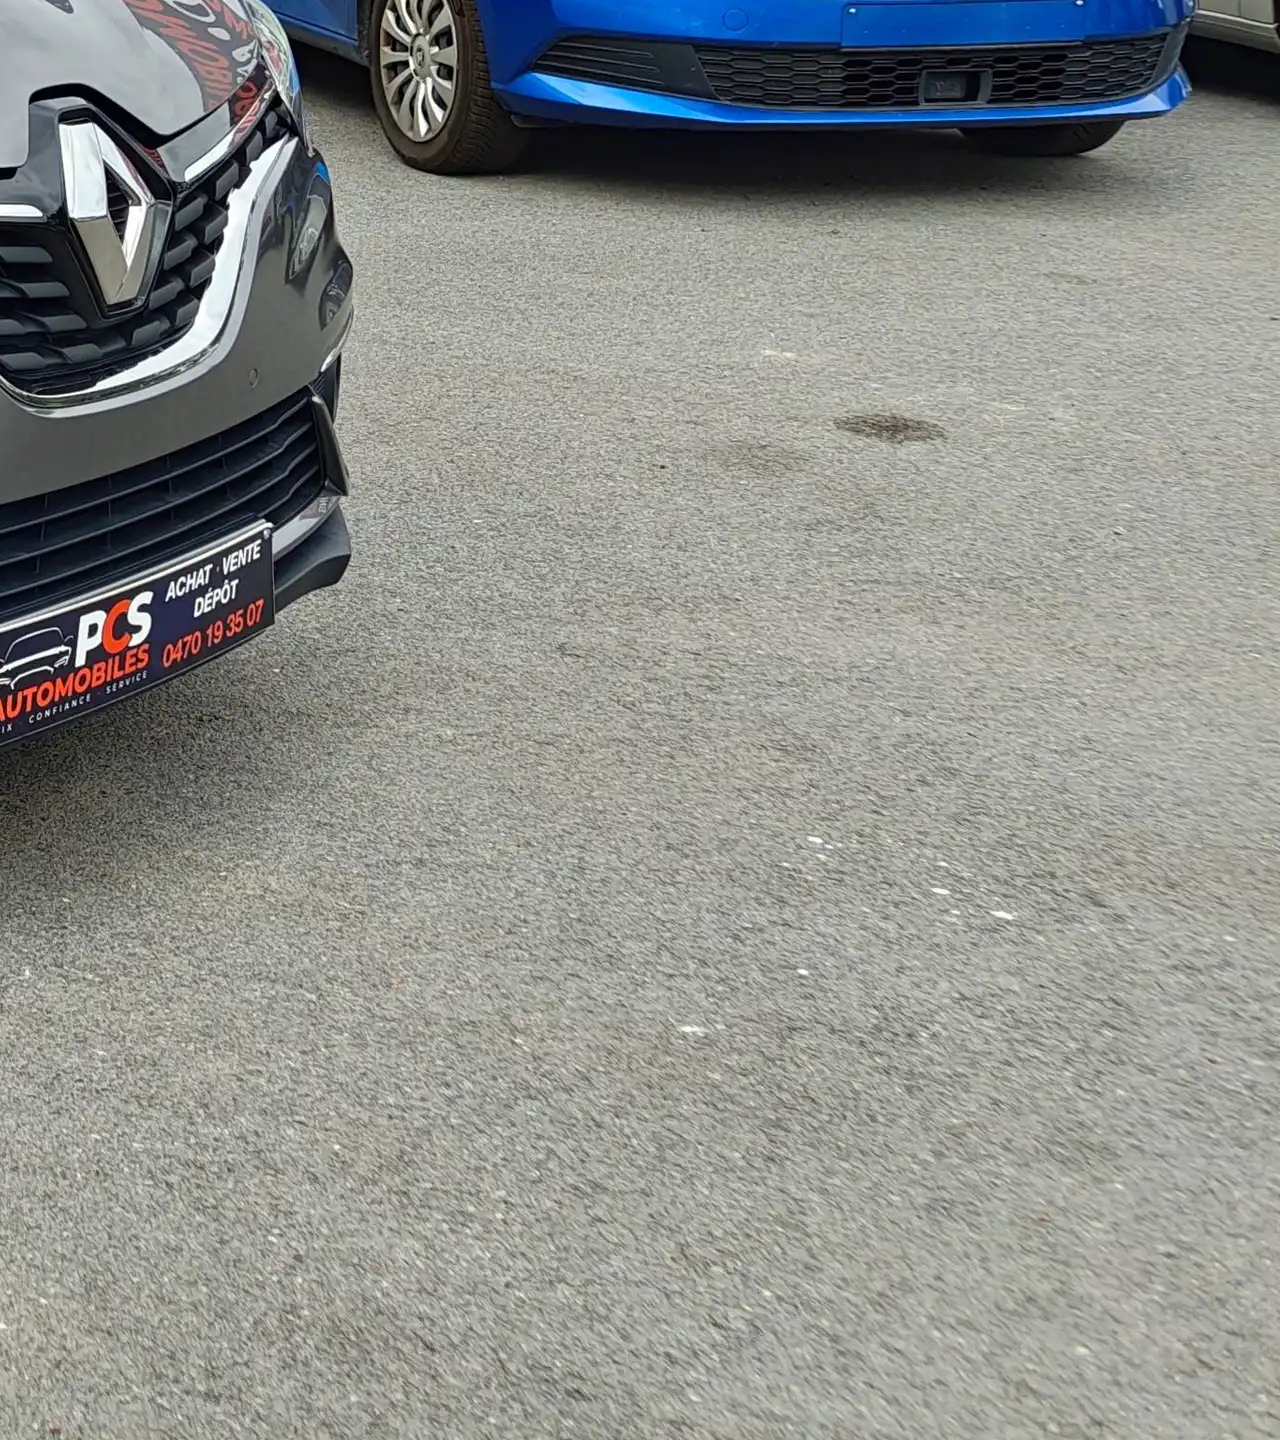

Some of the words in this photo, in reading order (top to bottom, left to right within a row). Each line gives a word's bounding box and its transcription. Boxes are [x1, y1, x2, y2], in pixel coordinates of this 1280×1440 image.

[164, 563, 213, 602] ACHAT
[222, 539, 262, 576] VENTE
[193, 579, 239, 618] DÉPÔT
[74, 590, 154, 668] PCS
[162, 630, 202, 668] 0470
[205, 619, 224, 648] 19
[225, 608, 244, 637] 35
[246, 597, 265, 627] 07
[28, 693, 92, 724] CONFIANCE
[105, 670, 148, 695] SERVICE
